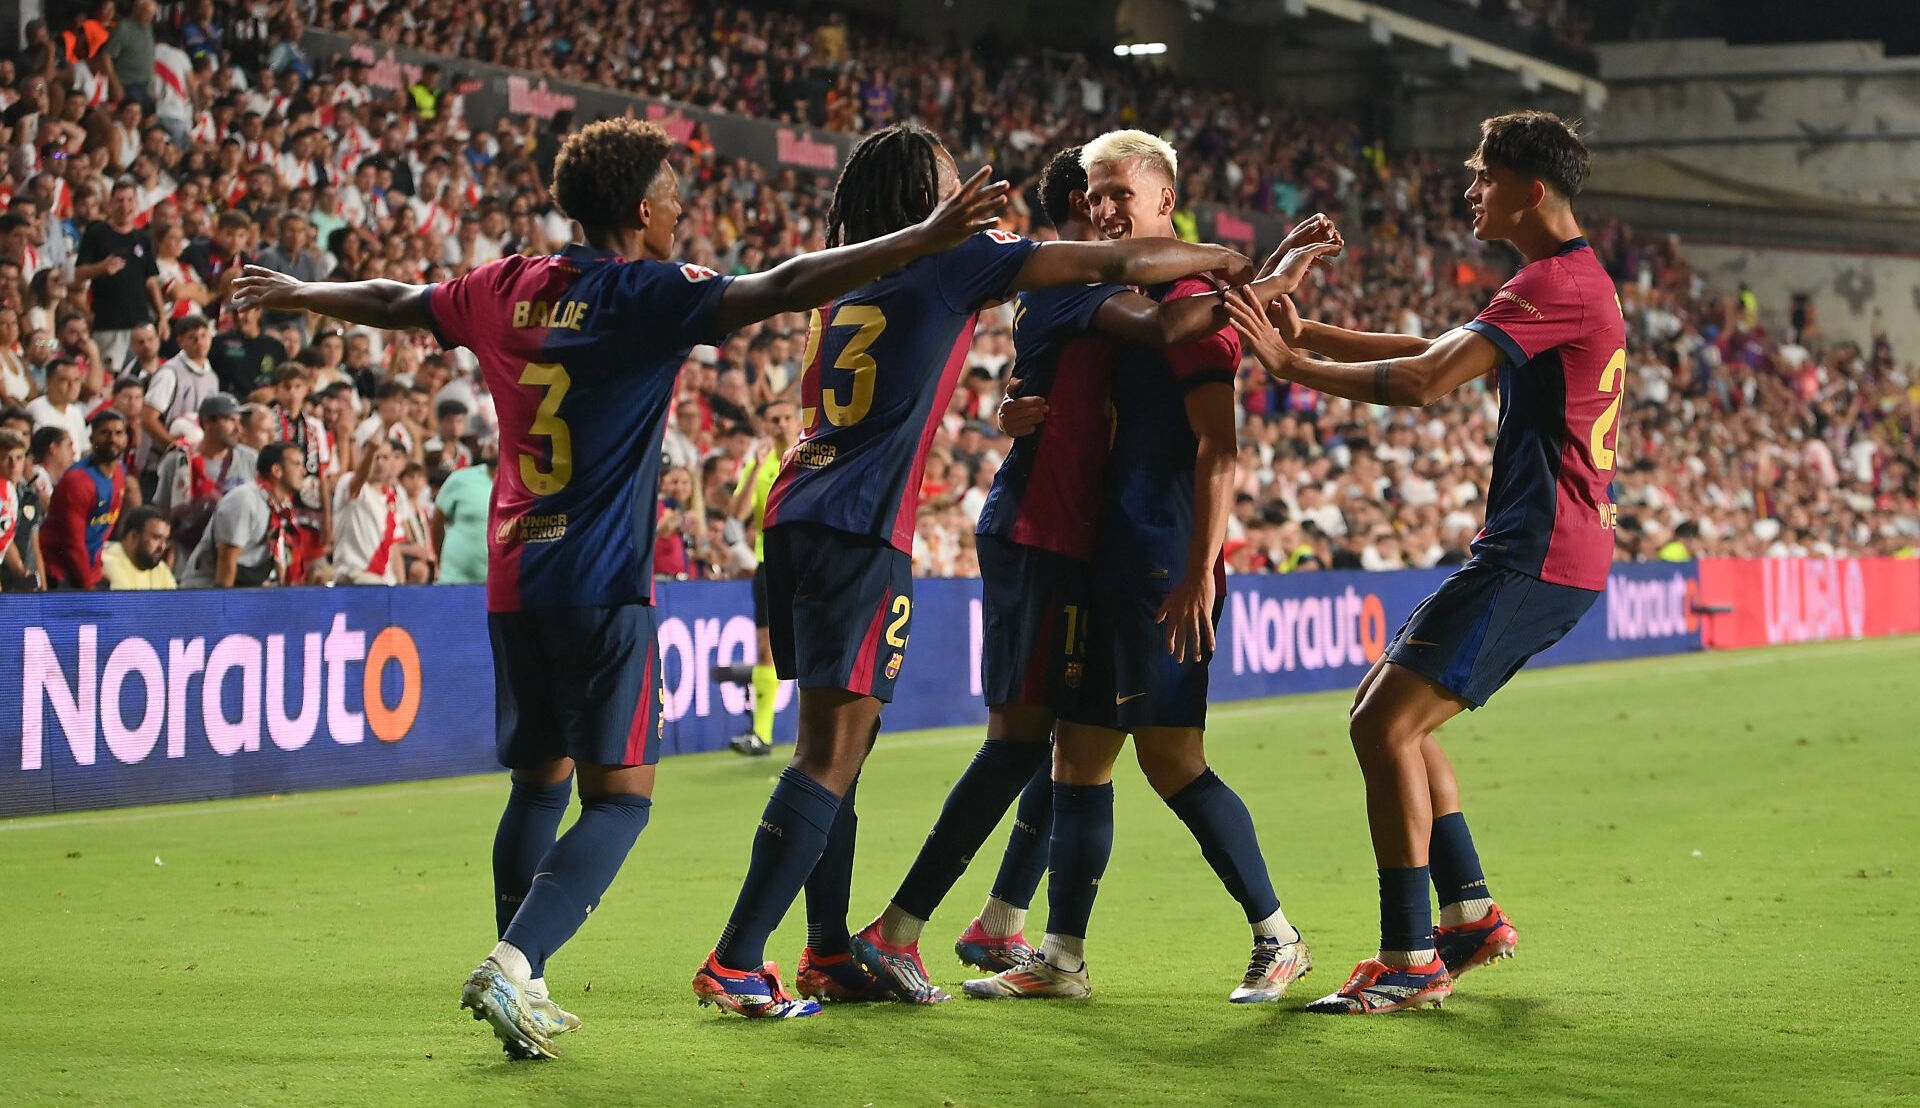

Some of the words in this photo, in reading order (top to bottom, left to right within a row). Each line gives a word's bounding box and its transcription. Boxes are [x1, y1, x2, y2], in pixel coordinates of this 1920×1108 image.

[512, 300, 588, 331] BALDE
[518, 362, 572, 496] 3
[1591, 348, 1626, 471] 2
[519, 513, 567, 527] UNHCR
[519, 525, 567, 539] ACNUR
[885, 595, 915, 648] 2
[1231, 586, 1386, 676] Norauto
[21, 613, 422, 770] Norauto
